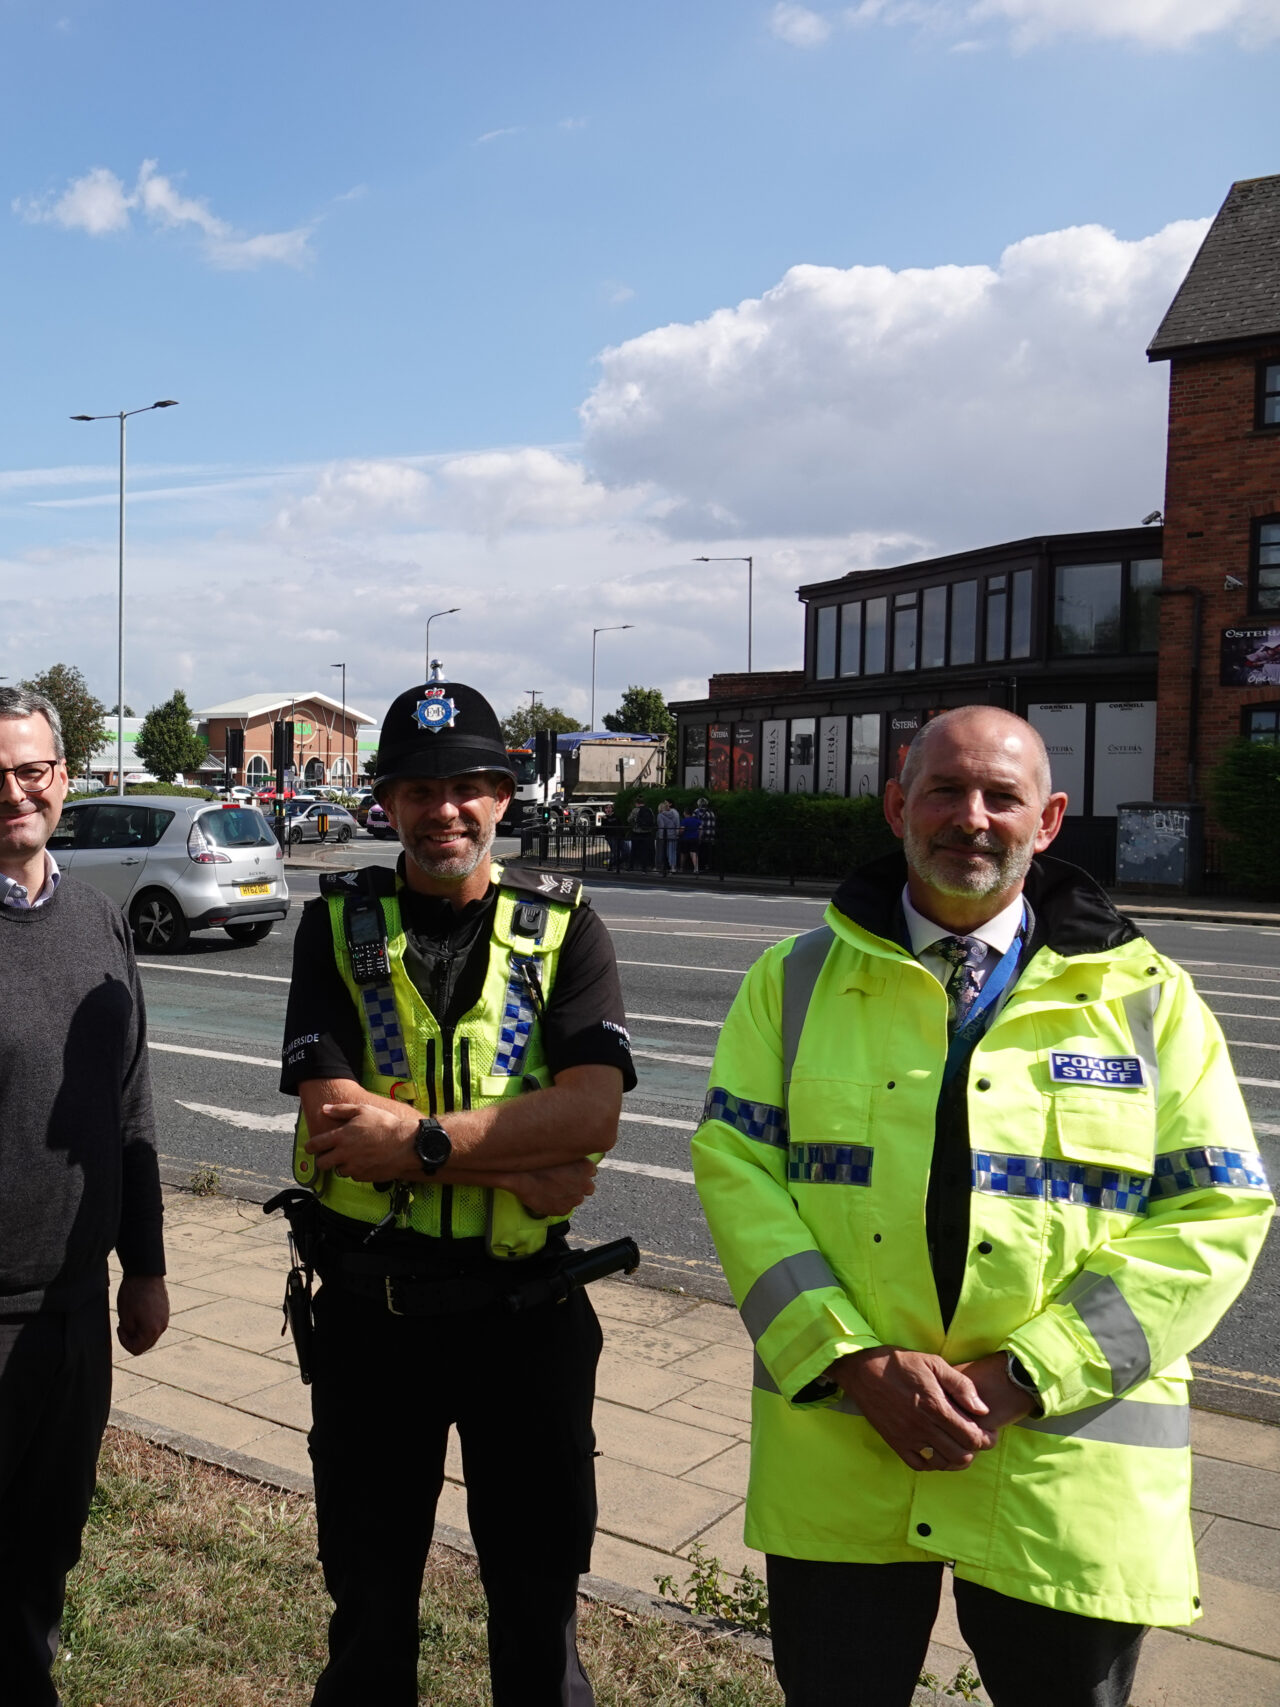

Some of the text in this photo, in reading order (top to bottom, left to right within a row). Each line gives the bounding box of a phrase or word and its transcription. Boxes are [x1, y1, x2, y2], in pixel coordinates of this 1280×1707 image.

[294, 723, 312, 736] SDA
[1055, 1055, 1138, 1071] POLICE
[1062, 1066, 1132, 1082] STAFF
